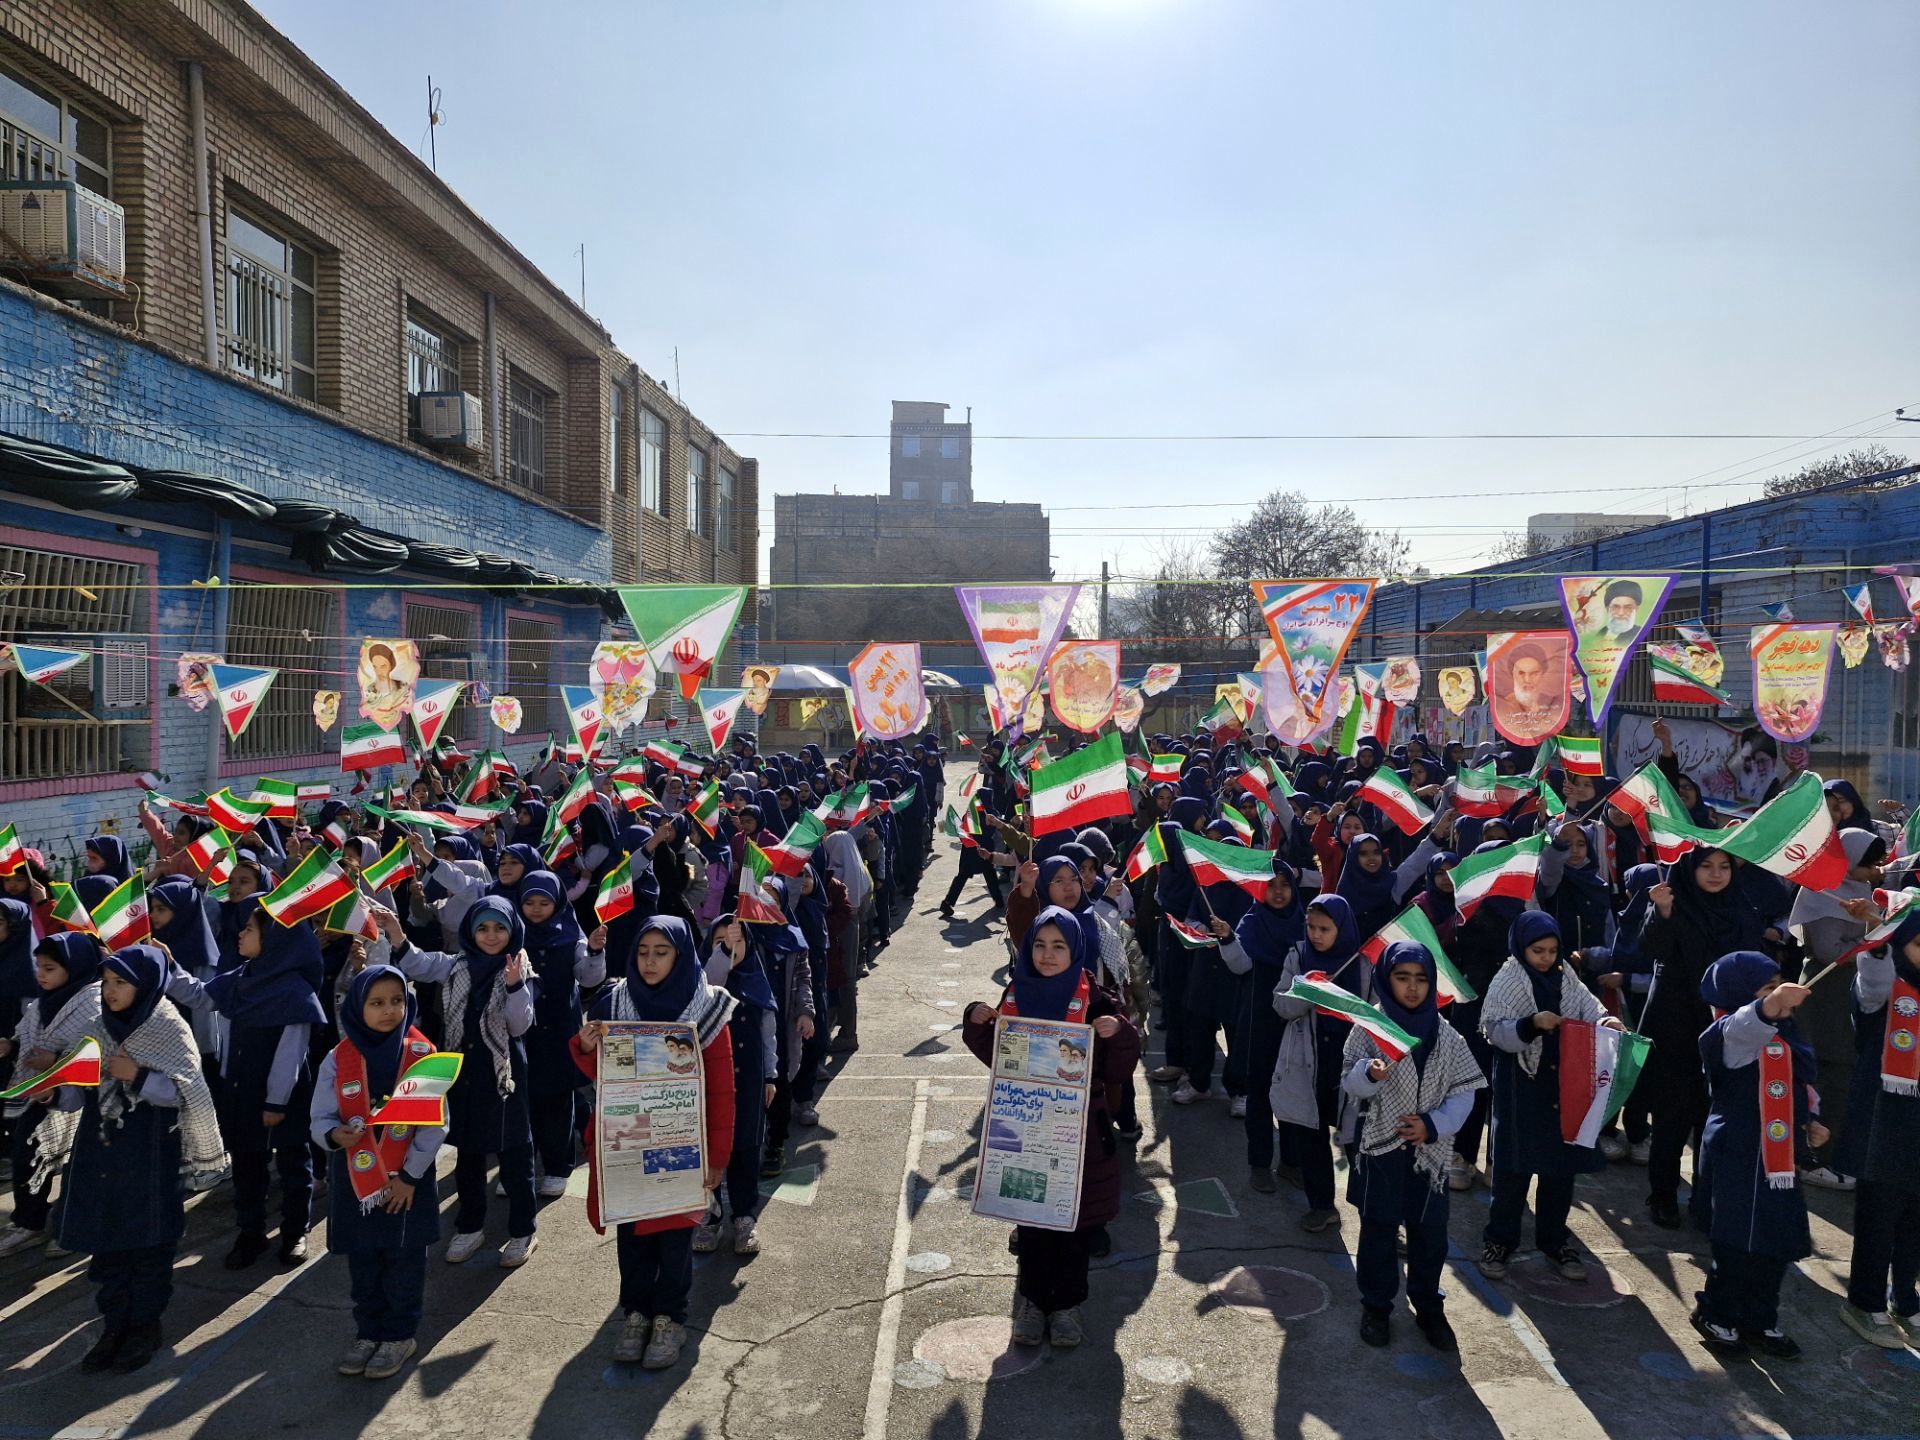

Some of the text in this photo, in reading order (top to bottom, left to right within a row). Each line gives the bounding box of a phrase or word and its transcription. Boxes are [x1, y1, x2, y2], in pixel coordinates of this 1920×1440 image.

[1301, 593, 1360, 616] ۲۲ بهمن
[1029, 645, 1040, 655] ۲۲
[1767, 634, 1821, 660] دهه فجر
[865, 650, 896, 692] ۲۲ بهمن
[675, 1089, 697, 1100] تاریخ
[994, 1080, 1023, 1096] مهرآباد
[1022, 1088, 1051, 1098] نظامی
[641, 1090, 675, 1101] بازگشت
[993, 1096, 1027, 1108] جلوگیری
[643, 1100, 676, 1113] خمینی
[676, 1097, 695, 1111] امام
